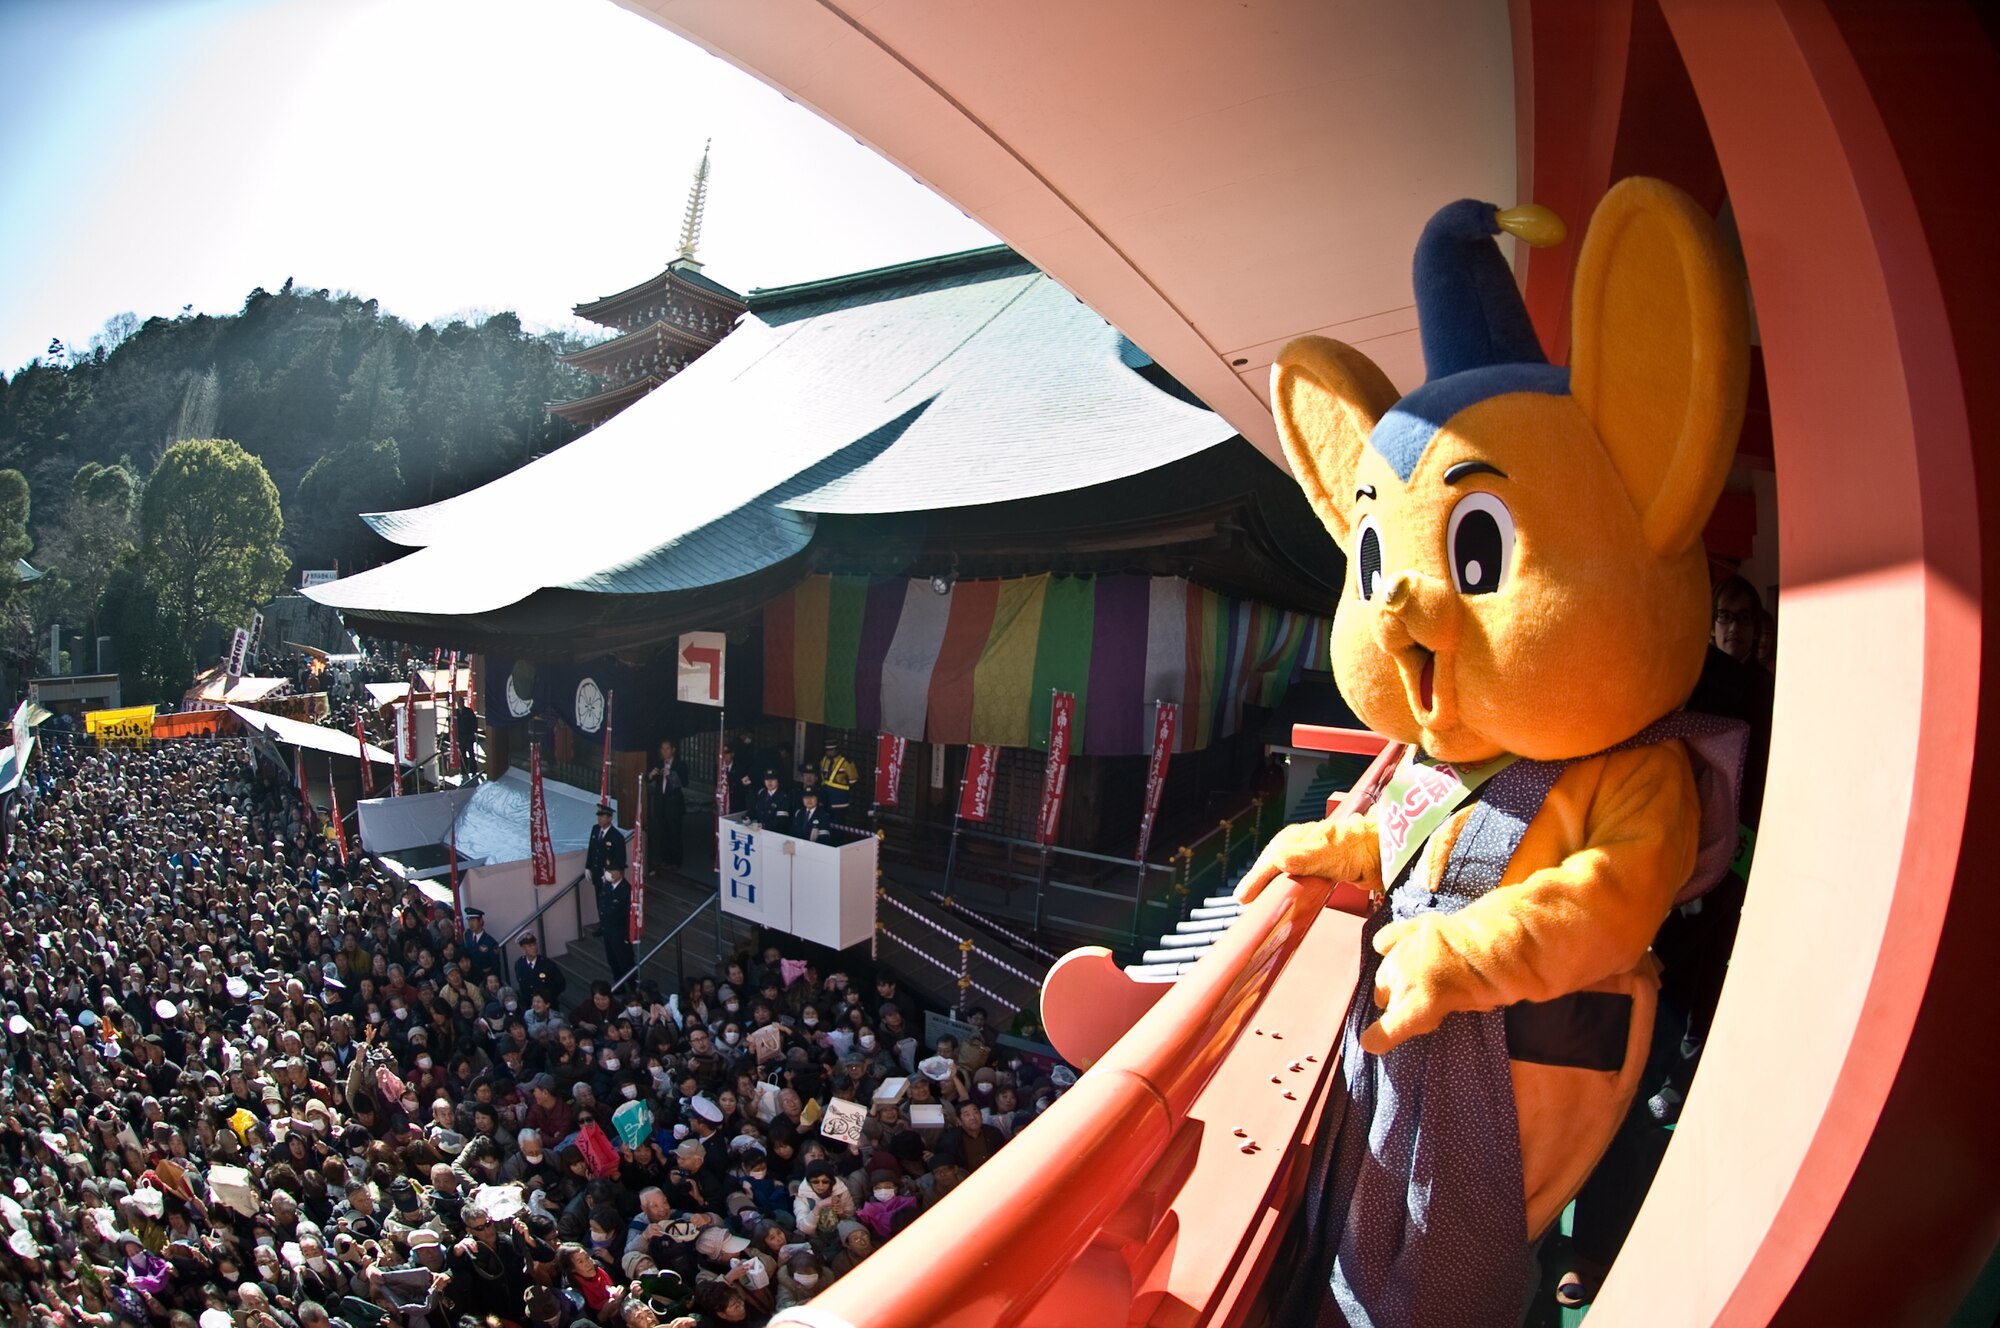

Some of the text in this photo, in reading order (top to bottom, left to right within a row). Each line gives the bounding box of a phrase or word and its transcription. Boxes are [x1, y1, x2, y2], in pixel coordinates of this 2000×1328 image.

[103, 723, 144, 737] 干しいも
[728, 829, 757, 904] 昇り口
